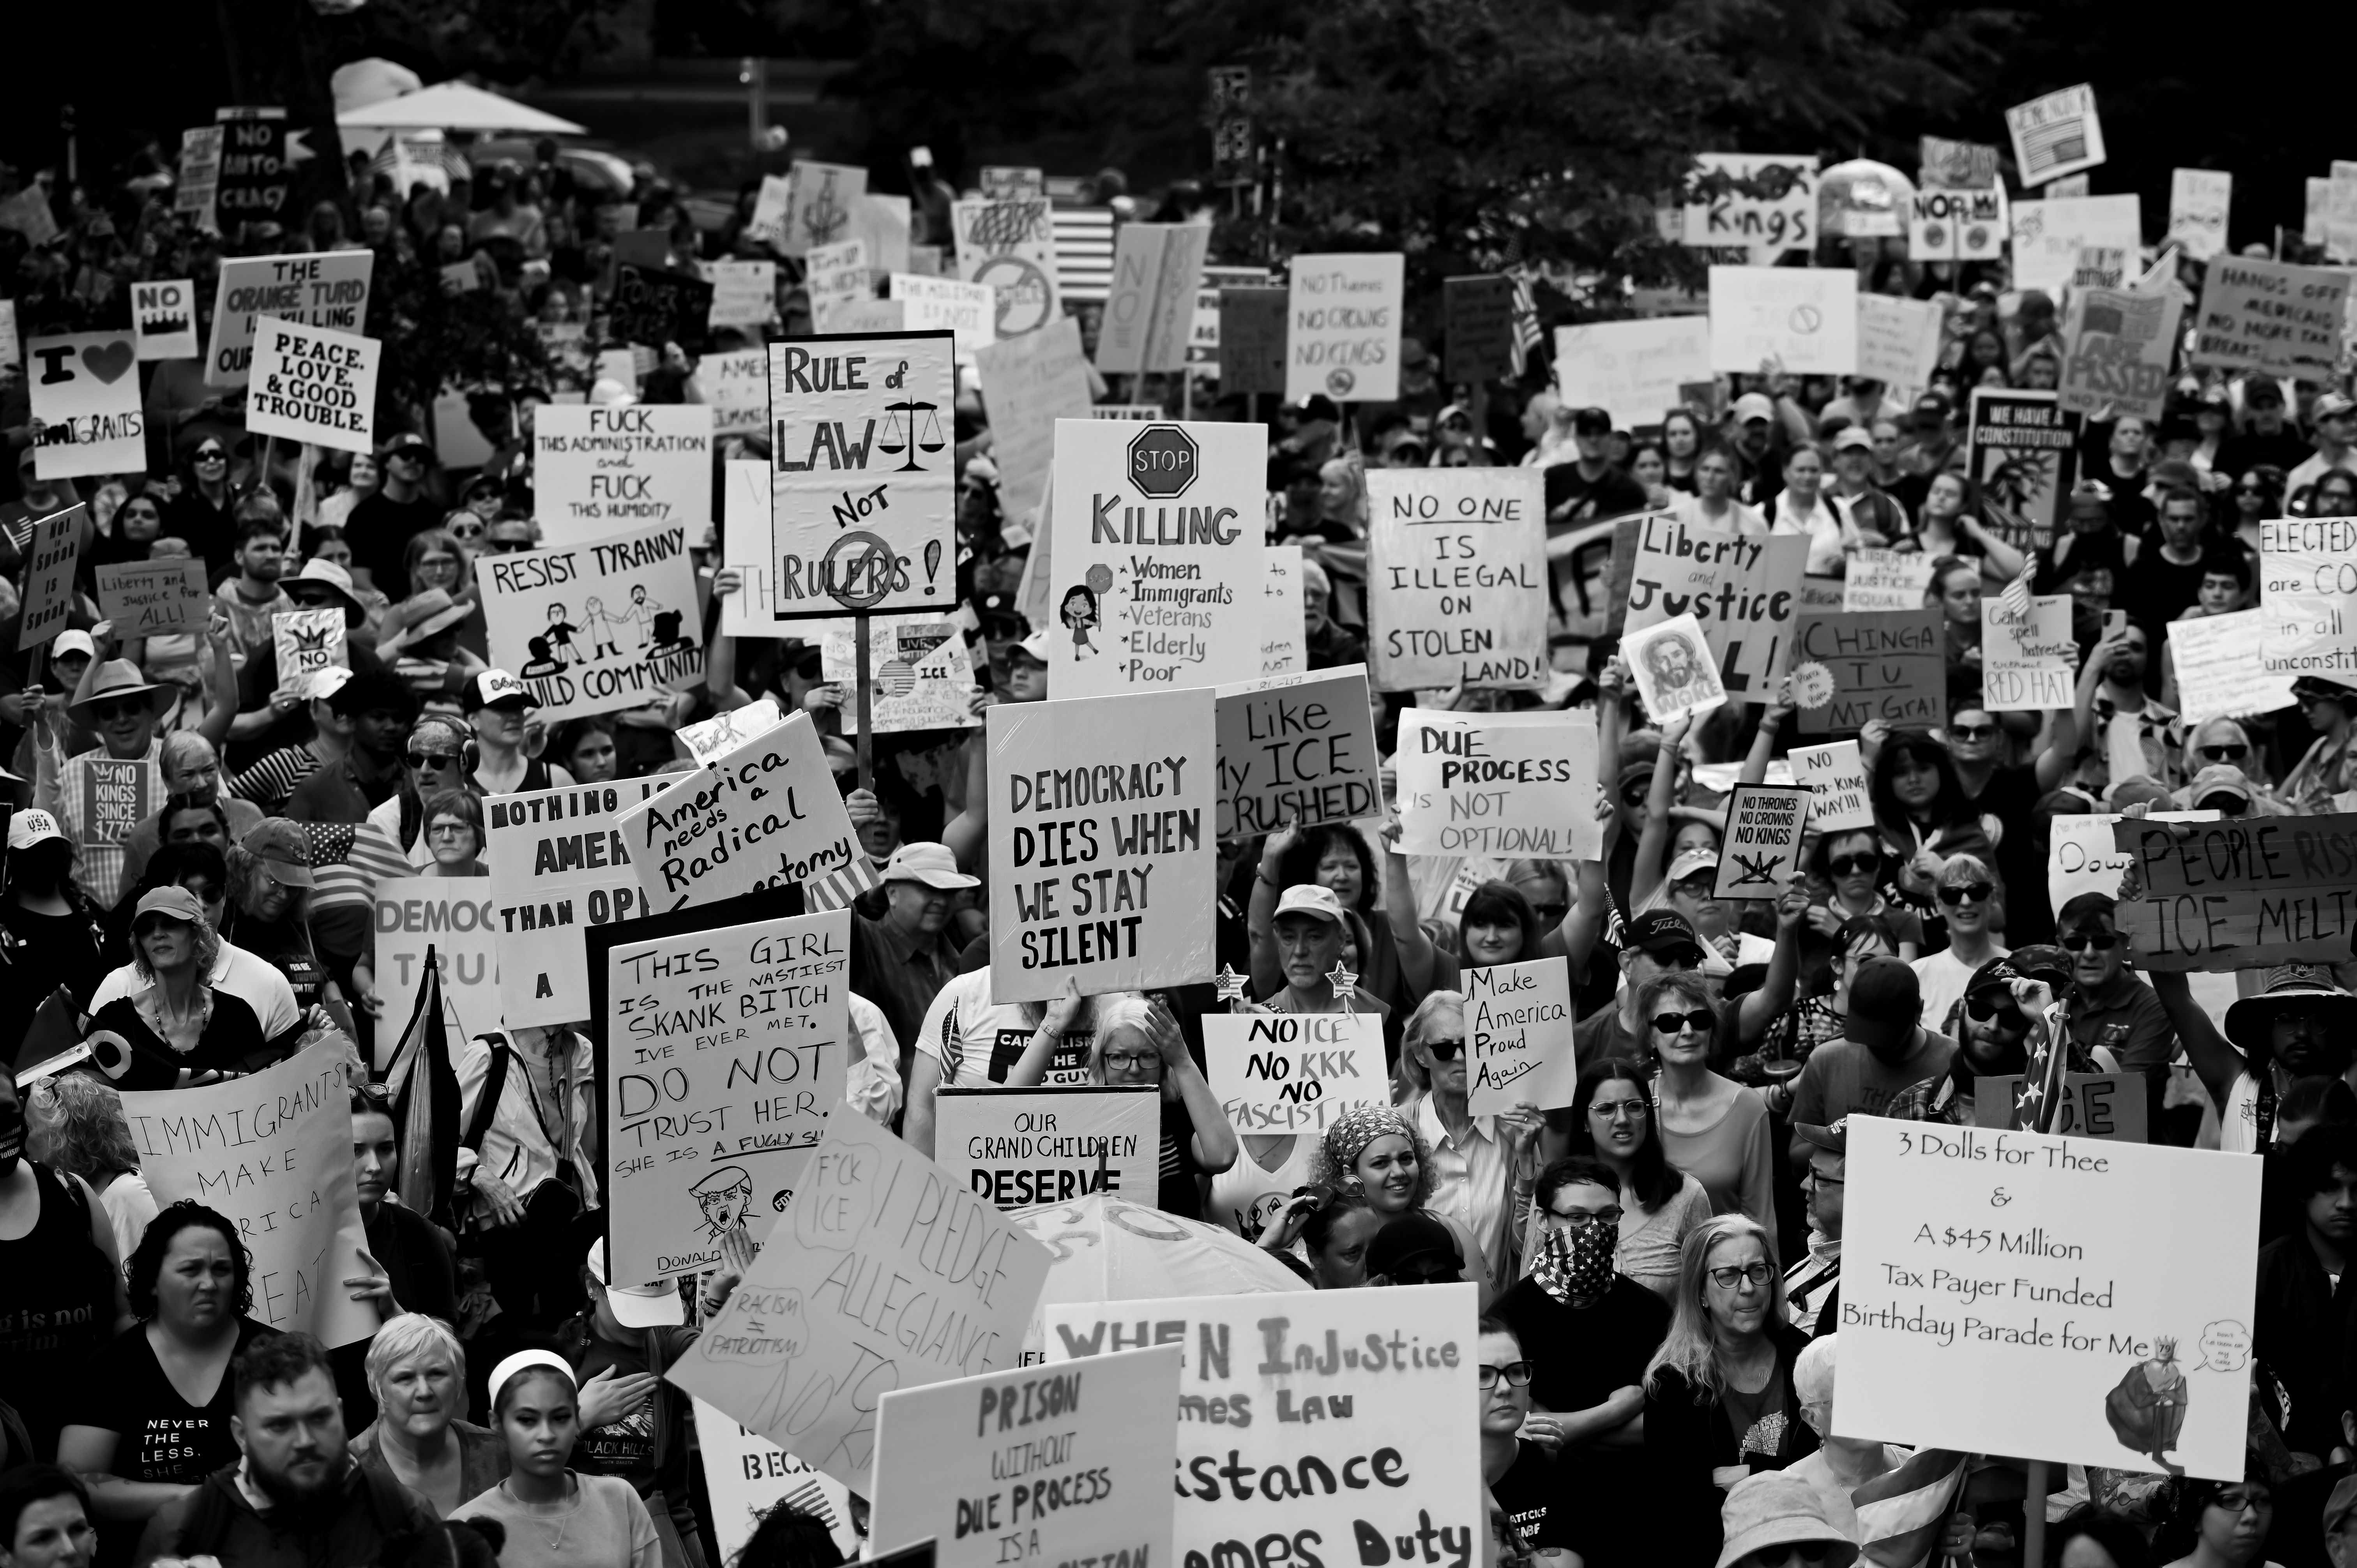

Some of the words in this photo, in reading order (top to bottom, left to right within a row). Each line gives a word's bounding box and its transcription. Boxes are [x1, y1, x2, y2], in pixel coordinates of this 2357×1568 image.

[236, 125, 271, 145] NO
[1913, 195, 1950, 220] NO
[1708, 200, 1808, 245] Kings
[272, 260, 321, 283] THE
[228, 287, 300, 313] ORANGE
[311, 279, 364, 305] TURD
[2221, 268, 2289, 293] HANDS
[2301, 285, 2343, 302] OFF
[138, 286, 181, 310] NO
[1298, 309, 1323, 331] NO
[2206, 314, 2235, 331] NO
[276, 334, 365, 370] PEACE.
[1296, 344, 1324, 366] NO
[34, 345, 76, 385] I
[267, 374, 284, 395] &
[288, 379, 356, 409] GOOD
[254, 393, 368, 434] TROUBLE.
[590, 409, 655, 433] FUCK
[1990, 405, 2011, 424] WE
[2014, 407, 2051, 426] HAVE
[539, 436, 567, 452] THIS
[572, 435, 706, 452] ADMINISTRATION
[777, 418, 876, 471] LAW
[1976, 427, 2074, 448] CONSTITUTION
[597, 455, 635, 468] and
[1135, 449, 1191, 472] STOP
[590, 475, 653, 500] FUCK
[569, 502, 602, 518] THIS
[607, 503, 671, 520] HUMIDITY
[832, 483, 889, 529] NOT
[1393, 493, 1439, 519] NO
[1458, 497, 1522, 521] ONE
[1091, 493, 1242, 546] KILLING
[1435, 535, 1475, 560] IS
[1642, 516, 1763, 572] Liberty
[493, 553, 578, 594] RESIST
[591, 527, 684, 576] TYRANNY
[1130, 555, 1201, 580] Women
[1270, 562, 1286, 576] to
[101, 576, 154, 592] Liberty
[164, 572, 186, 586] and
[1387, 564, 1538, 590] ILLEGAL
[1687, 570, 1717, 588] and
[2269, 577, 2302, 591] are
[1130, 580, 1233, 609] Immigrants
[1264, 584, 1284, 597] to
[1848, 591, 1905, 607] EQUAL
[139, 603, 186, 626] ALL!
[1129, 604, 1212, 629] Veterans
[1440, 596, 1472, 615] ON
[2281, 622, 2299, 635] in
[2314, 609, 2342, 635] all
[1131, 630, 1205, 662] Elderly
[1388, 629, 1493, 658] STOLEN
[300, 651, 327, 665] NO
[1129, 659, 1182, 682] Poor
[1262, 657, 1293, 671] NOT
[1463, 656, 1541, 683] LAND!
[921, 667, 948, 679] ICE
[1848, 662, 1901, 683] TU
[1420, 726, 1491, 759] DUE
[1807, 751, 1832, 770] NO
[113, 764, 136, 785] NO
[1010, 756, 1187, 813] DEMOCRACY
[96, 784, 136, 802] KINGS
[647, 751, 789, 849] America
[1741, 796, 1756, 810] NO
[1757, 796, 1797, 811] THRONES
[96, 802, 136, 821] SINCE
[1413, 791, 1432, 810] IS
[1451, 791, 1511, 821] NOT
[1739, 811, 1754, 825] NO
[1754, 812, 1794, 826] CROWNS
[27, 819, 51, 832] USA
[1013, 818, 1099, 868] DIES
[1111, 808, 1201, 857] WHEN
[1735, 826, 1753, 844] NO
[1754, 827, 1792, 845] KINGS
[659, 786, 806, 893] Radical
[1440, 826, 1573, 855] OPTIONAL!
[1014, 877, 1062, 923] WE
[1072, 863, 1154, 916] STAY
[1021, 916, 1142, 969] SILENT
[620, 948, 720, 984] THIS
[750, 932, 844, 964] GIRL
[619, 994, 660, 1015] IS
[688, 979, 733, 1000] THE
[749, 959, 847, 987] NASTIEST
[629, 1002, 726, 1040] SKANK
[740, 984, 828, 1019] BITCH
[1474, 1000, 1567, 1032] America
[634, 1045, 675, 1065] IVE
[696, 1028, 750, 1051] EVER
[767, 1015, 816, 1031] MET.
[1248, 1018, 1298, 1045] NO
[1304, 1017, 1350, 1046] ICE
[1245, 1051, 1290, 1081] NO
[1300, 1049, 1360, 1079] KKK
[1475, 1061, 1534, 1091] Again
[619, 1067, 690, 1120] DO
[727, 1041, 836, 1089] NOT
[1279, 1081, 1323, 1104] NO
[131, 1062, 342, 1157] IMMIGRANTS
[620, 1106, 733, 1148] TRUST
[754, 1091, 829, 1124] HER.
[1014, 1112, 1057, 1133] OUR
[1898, 1132, 1912, 1157] 3
[1921, 1130, 1987, 1161] Dolls
[1994, 1134, 2035, 1165] for
[2041, 1141, 2109, 1173] Thee
[198, 1148, 297, 1196] MAKE
[774, 1191, 793, 1211] FDT
[1990, 1187, 2012, 1207] &
[1914, 1223, 1936, 1246] A
[1942, 1225, 1991, 1254] $45
[1999, 1227, 2083, 1261] Million
[657, 1250, 721, 1271] DONALD
[1823, 1263, 1839, 1277] Nikon
[1880, 1263, 1924, 1289] Tax
[1932, 1269, 2006, 1305] Payer
[2013, 1278, 2113, 1309] Funded
[21, 1308, 46, 1330] is
[54, 1302, 93, 1326] not
[735, 1293, 799, 1316] RACISM
[1842, 1301, 1955, 1347] Birthday
[1963, 1316, 2054, 1348] Parade
[2060, 1320, 2102, 1353] for
[2108, 1333, 2149, 1358] Me
[708, 1335, 799, 1356] PATRIOTISM
[2158, 1343, 2171, 1354] 79
[978, 1372, 1082, 1437] PRISON
[147, 1420, 209, 1429] NEVER
[144, 1433, 180, 1446] THE
[141, 1447, 201, 1463] LESS.
[992, 1432, 1076, 1481] WITHOUT
[143, 1464, 184, 1479] SHE
[955, 1494, 1001, 1540] DUE
[1012, 1467, 1113, 1525] PROCESS
